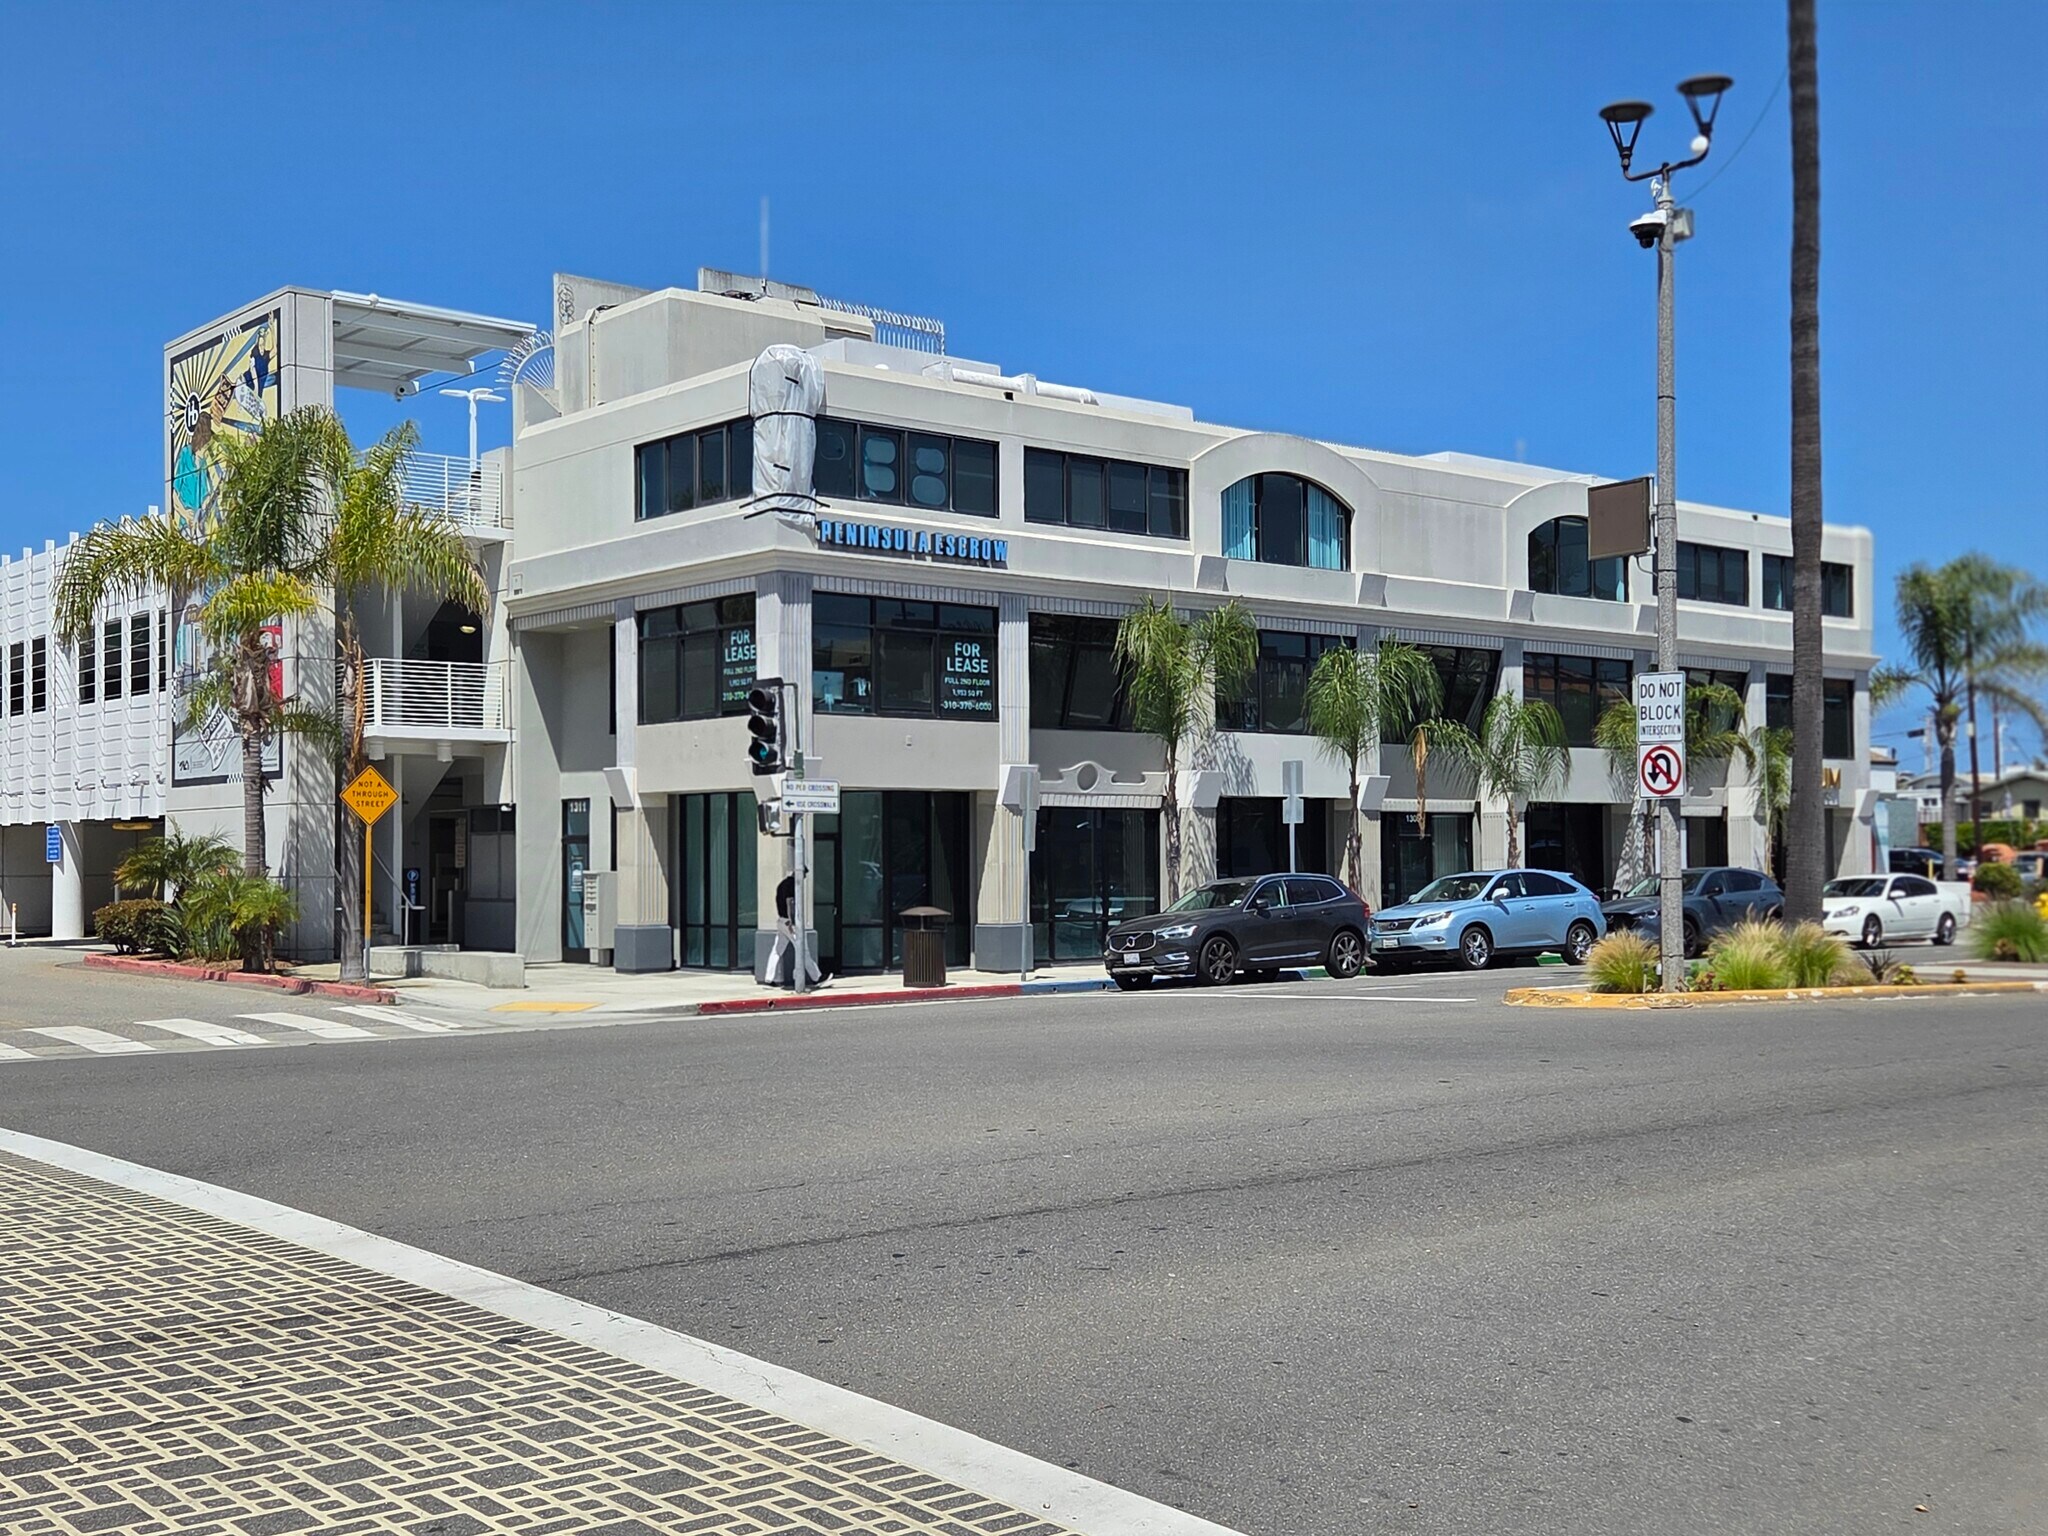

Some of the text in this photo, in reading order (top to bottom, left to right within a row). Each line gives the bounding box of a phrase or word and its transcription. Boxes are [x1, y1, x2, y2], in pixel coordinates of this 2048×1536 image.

[819, 519, 1009, 562] PENINSULA ESCROW
[730, 629, 750, 646] FOR
[724, 644, 757, 662] LEASE
[954, 642, 980, 657] FOR
[946, 656, 989, 673] LEASE
[944, 677, 960, 685] FULL
[972, 678, 991, 686] FLOOR
[1640, 682, 1681, 698] DO NOT
[1640, 705, 1681, 720] BLOCK
[1640, 725, 1681, 735] INTERSECTION
[352, 790, 389, 798] THROUGH
[355, 800, 385, 808] STREET
[570, 801, 587, 813] 1311
